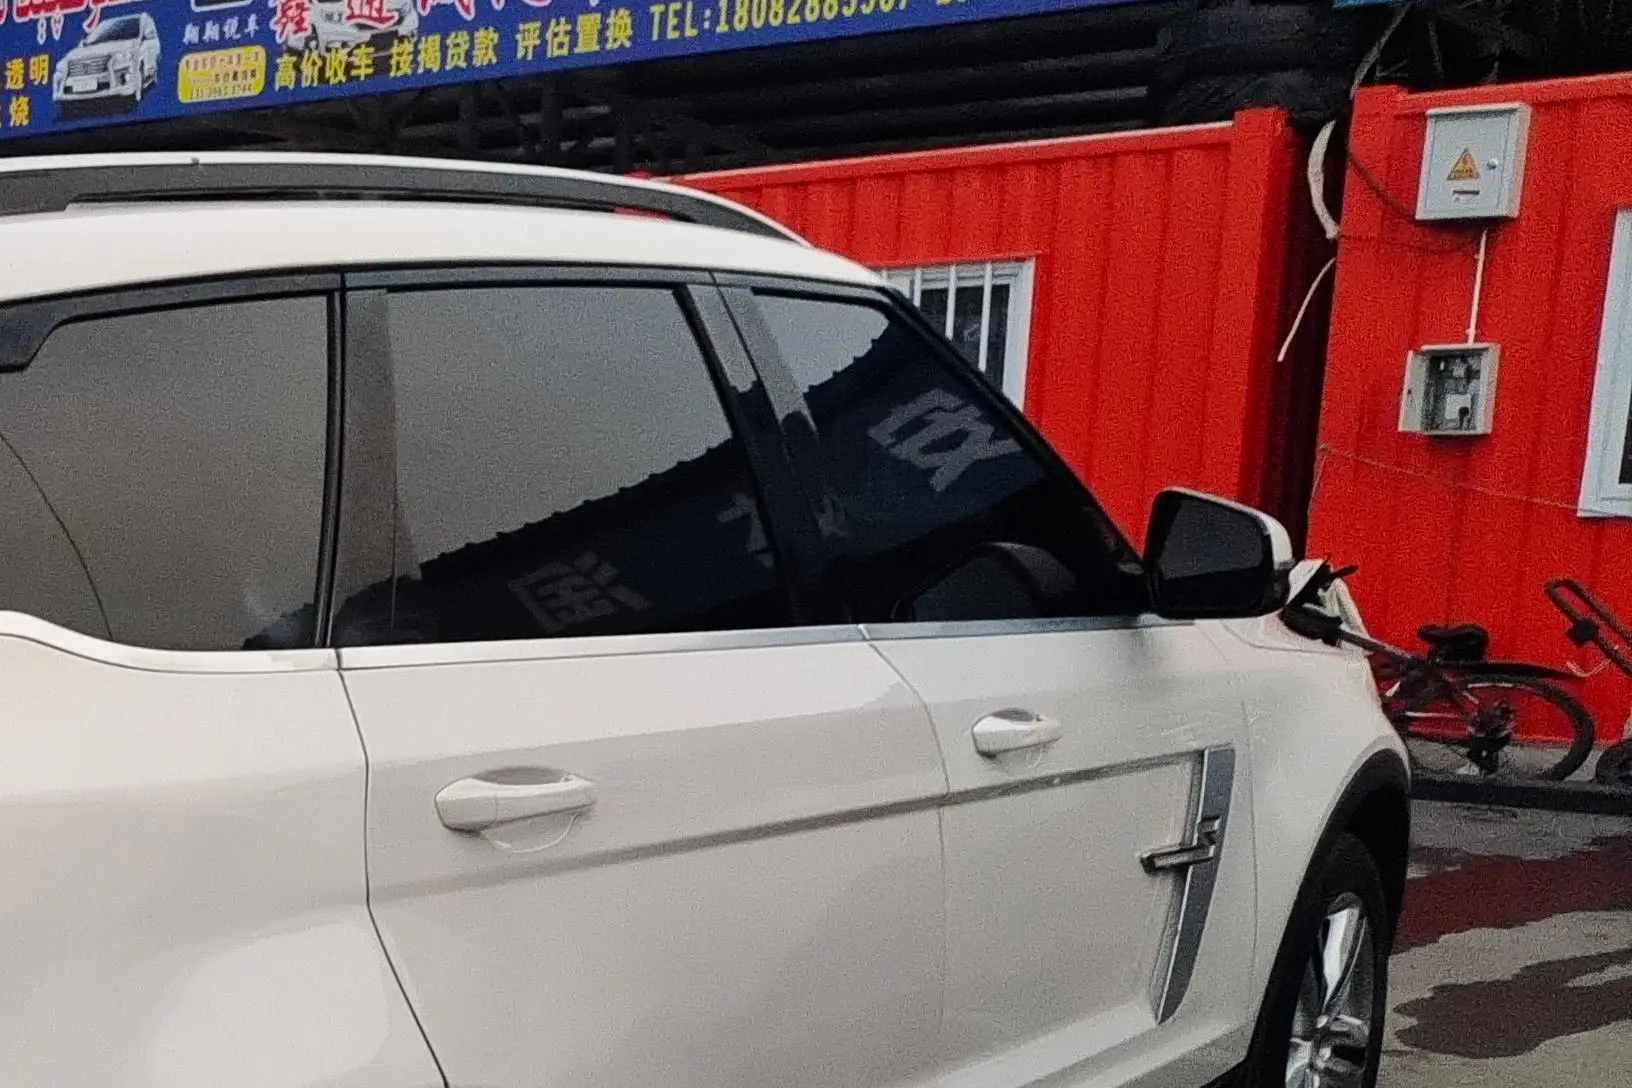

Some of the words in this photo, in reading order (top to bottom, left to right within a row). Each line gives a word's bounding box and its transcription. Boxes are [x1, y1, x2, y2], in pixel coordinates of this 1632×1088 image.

[275, 41, 376, 91] 高价收车
[389, 26, 500, 77] 按揭贷款
[516, 7, 633, 60] 评估置换
